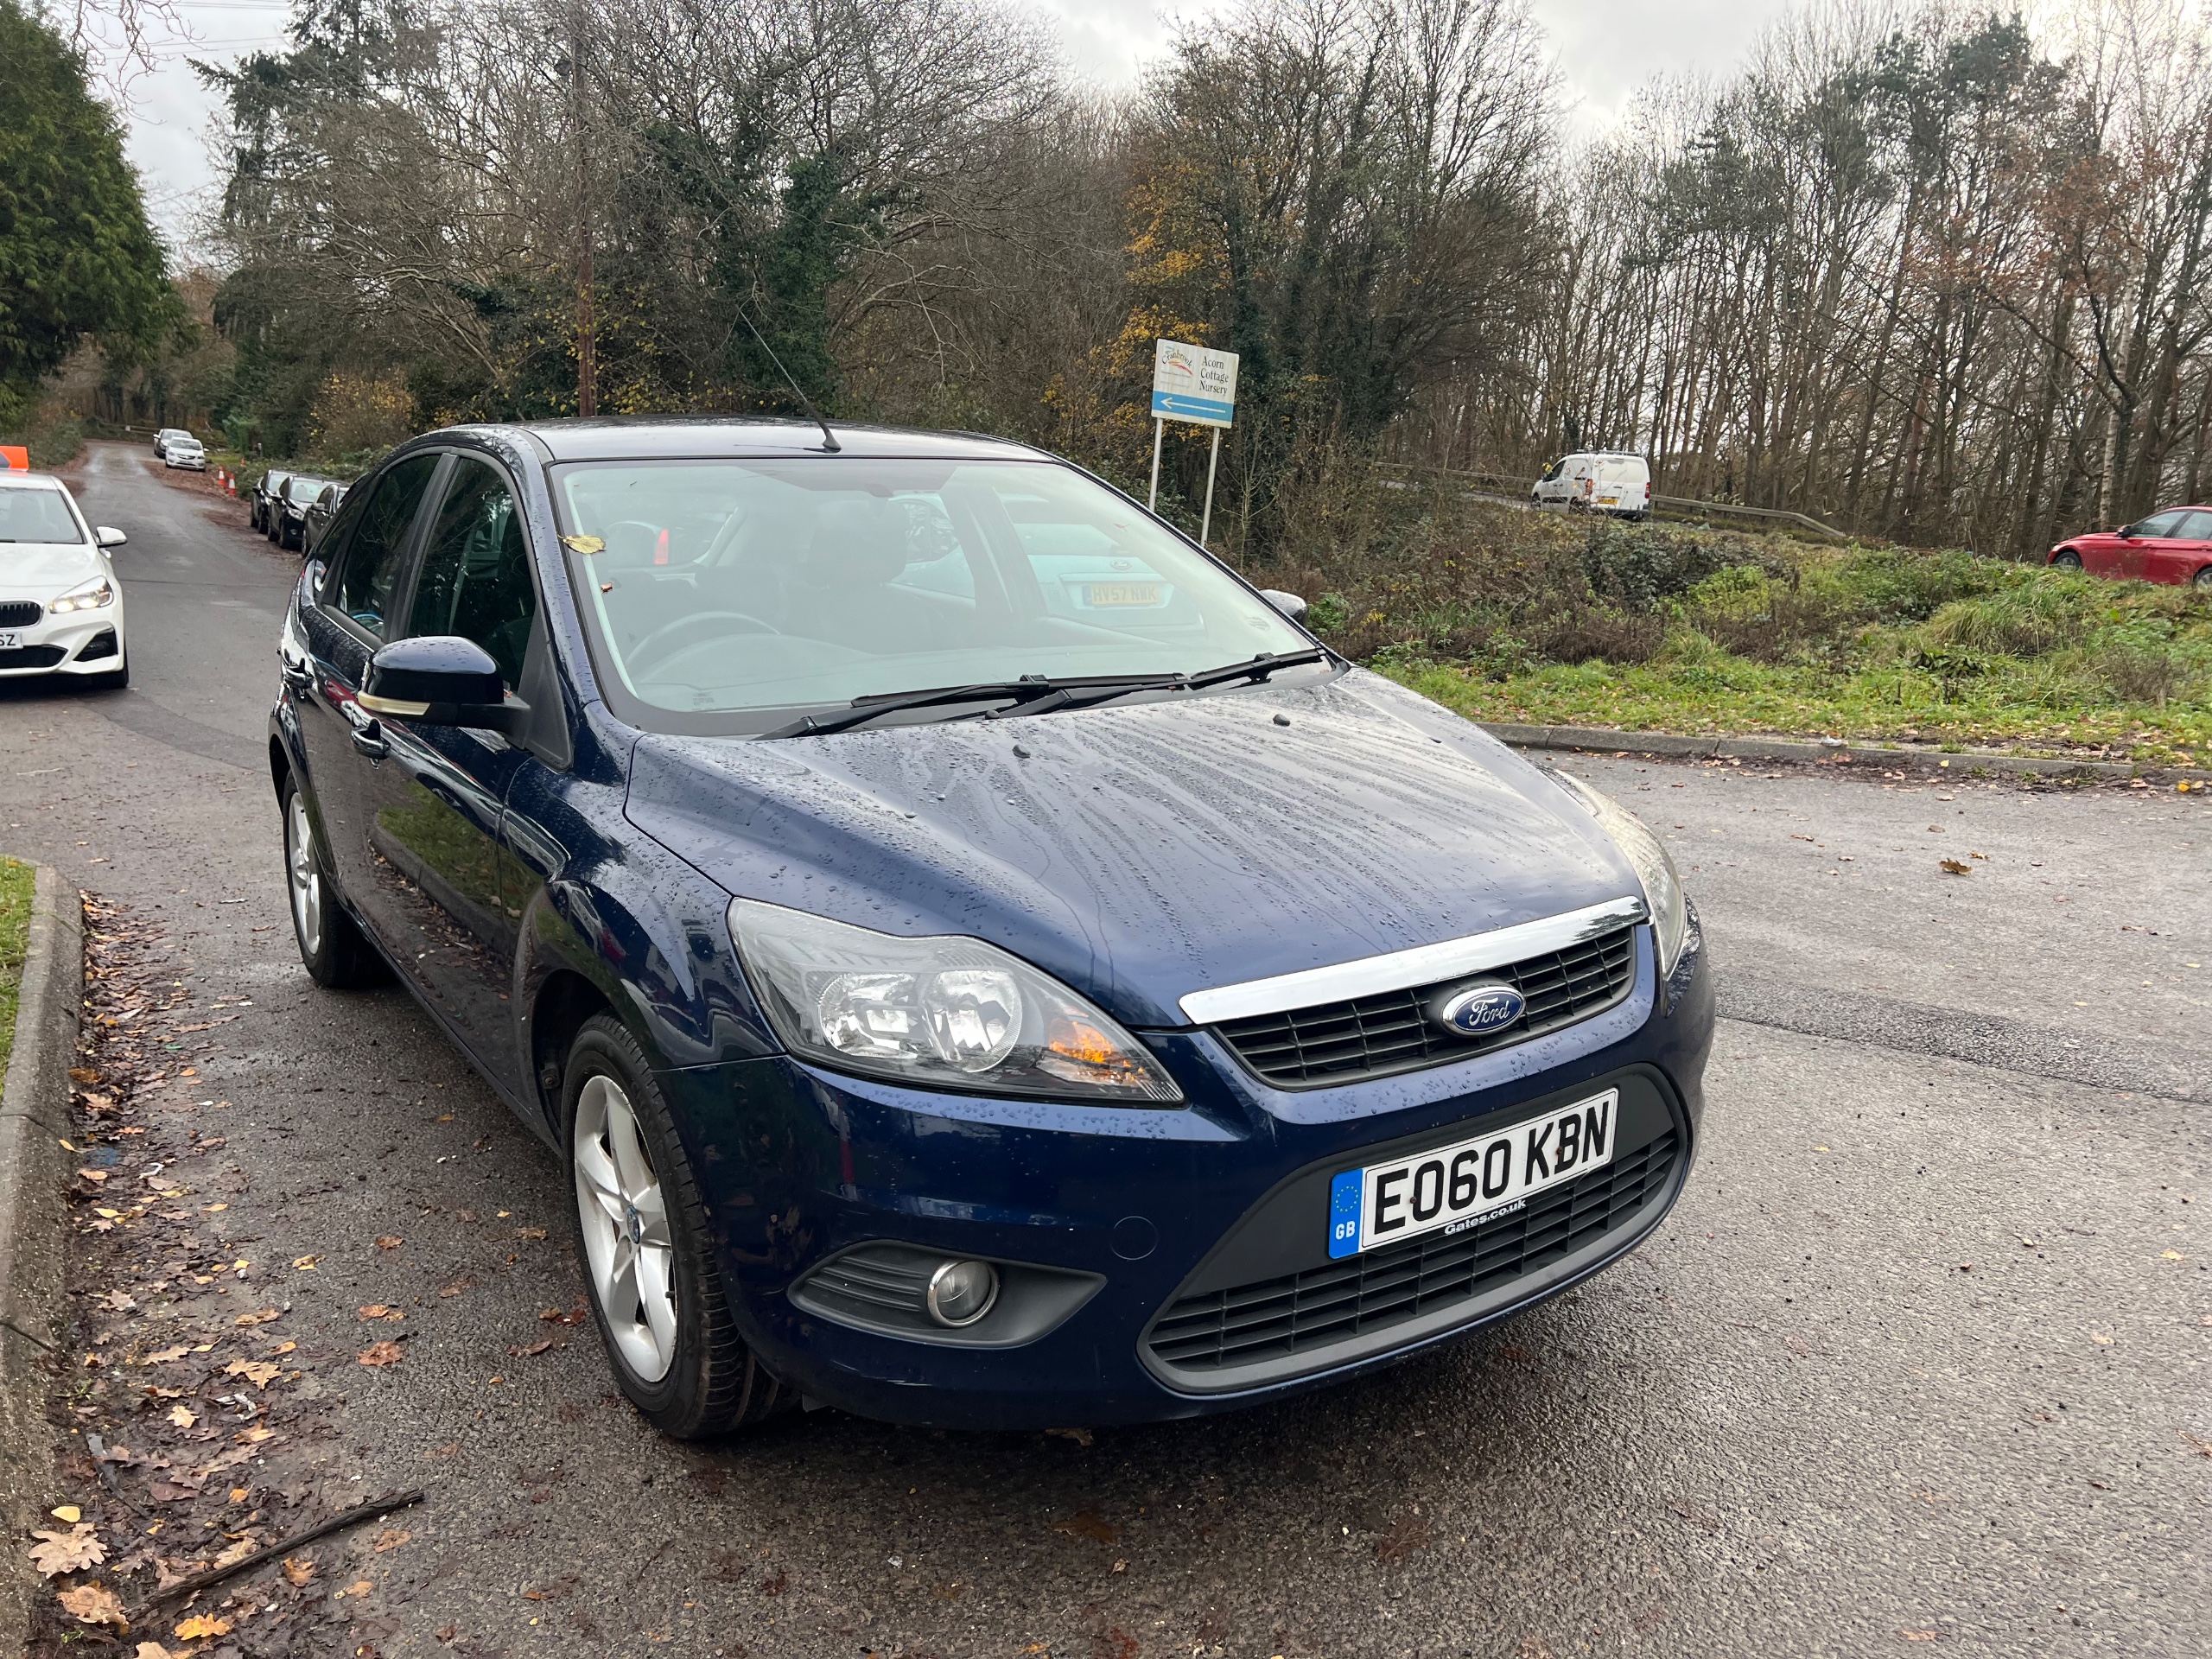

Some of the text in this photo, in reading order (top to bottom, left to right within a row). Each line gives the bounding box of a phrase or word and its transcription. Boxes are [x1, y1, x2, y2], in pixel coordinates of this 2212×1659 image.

[1161, 349, 1192, 368] Cranbrook
[1202, 356, 1224, 370] Acorn
[1200, 368, 1229, 384] Cottage
[1199, 380, 1228, 396] Nursery
[1469, 996, 1510, 1027] Ford
[1524, 1100, 1610, 1187] KBN
[1444, 1198, 1527, 1236] Gates.co.uk
[1335, 1220, 1356, 1240] GB
